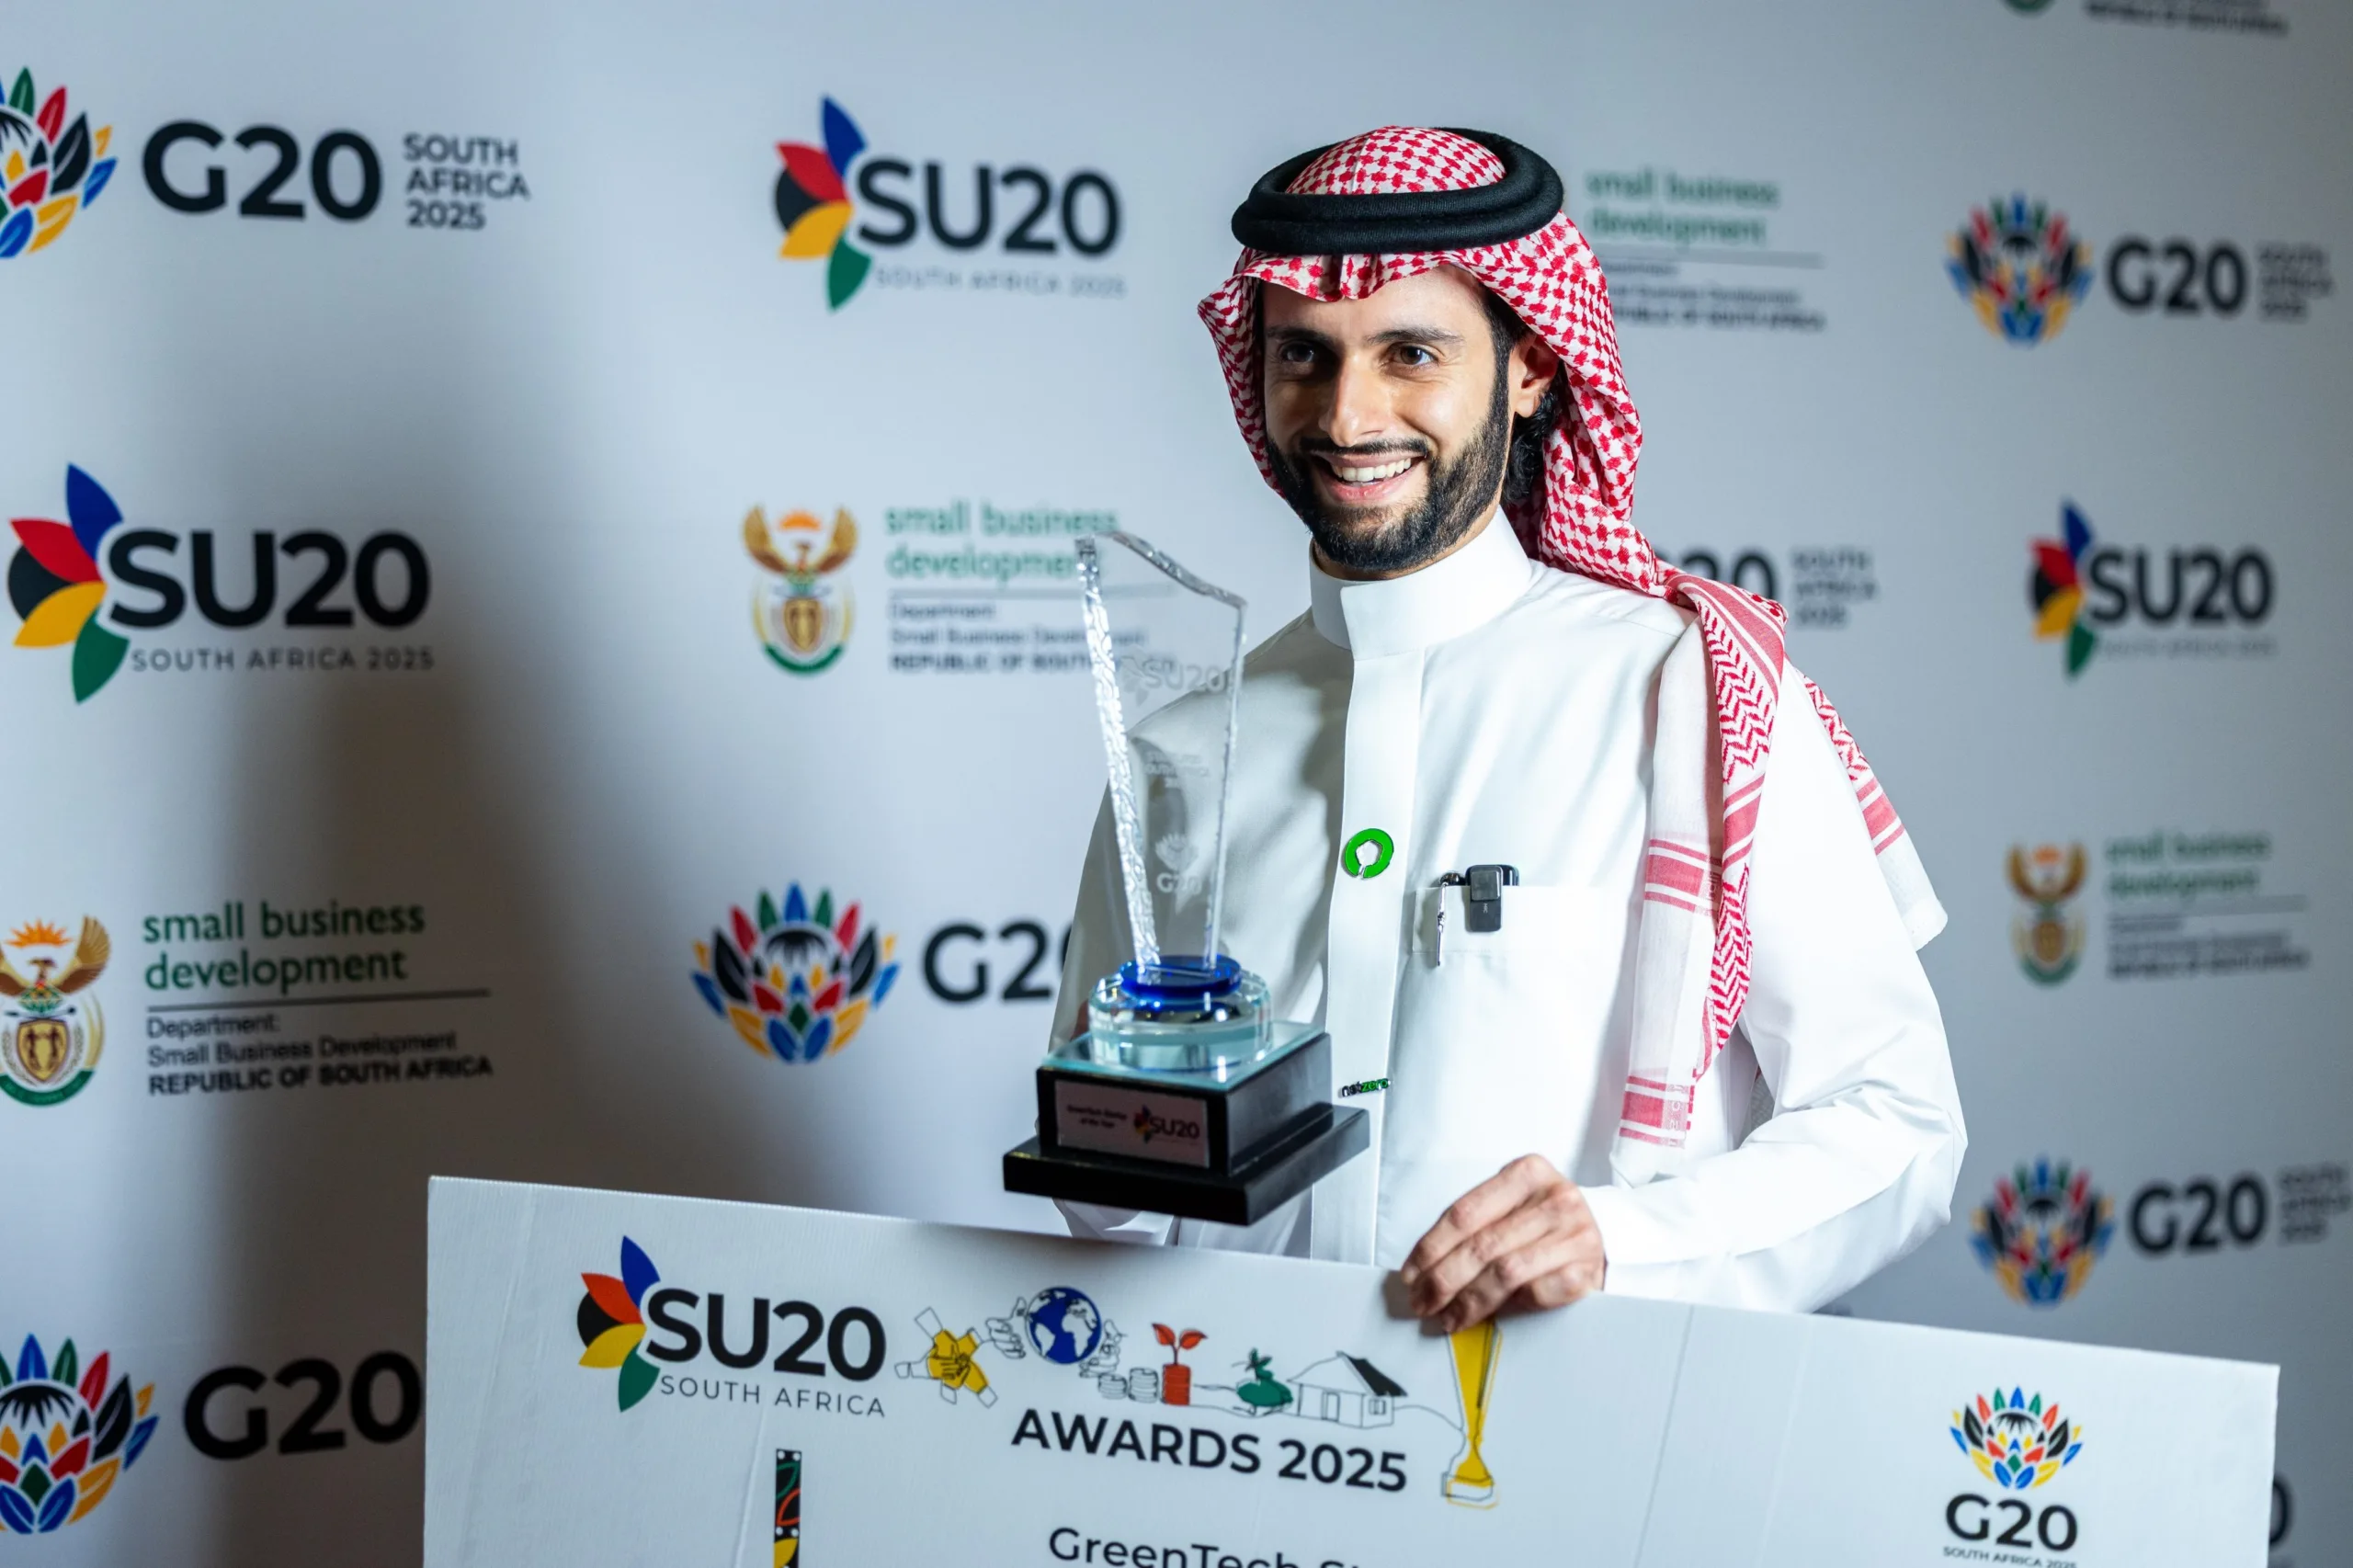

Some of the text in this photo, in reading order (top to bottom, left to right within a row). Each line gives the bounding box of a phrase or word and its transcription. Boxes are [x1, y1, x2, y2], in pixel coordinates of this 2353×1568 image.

[142, 119, 383, 222] G20
[404, 133, 517, 165] SOUTH
[405, 167, 530, 199] AFRICA
[405, 199, 485, 231] 2025
[856, 156, 1121, 258] SU20
[2108, 236, 2245, 314] G20
[884, 501, 970, 535] small
[107, 528, 432, 631] SU20
[2088, 547, 2275, 626] SU20
[131, 647, 434, 672] SOUTH AFRICA 2025
[143, 899, 426, 944] small business
[145, 949, 408, 994] development
[924, 922, 1073, 1003] G2
[147, 1031, 457, 1067] Small Business Development
[149, 1056, 494, 1096] REPUBLIC OF SOUTH AFRICA
[1149, 1117, 1200, 1140] SU20
[2128, 1172, 2268, 1256] G20
[646, 1288, 886, 1381] SU20
[184, 1349, 423, 1460] G20
[661, 1375, 885, 1418] SOUTH AFRICA
[1012, 1408, 1407, 1492] AWARDS 2025
[1946, 1493, 2077, 1551] G20
[1943, 1546, 1989, 1561] SOUTH
[1994, 1552, 2042, 1568] AFRICA
